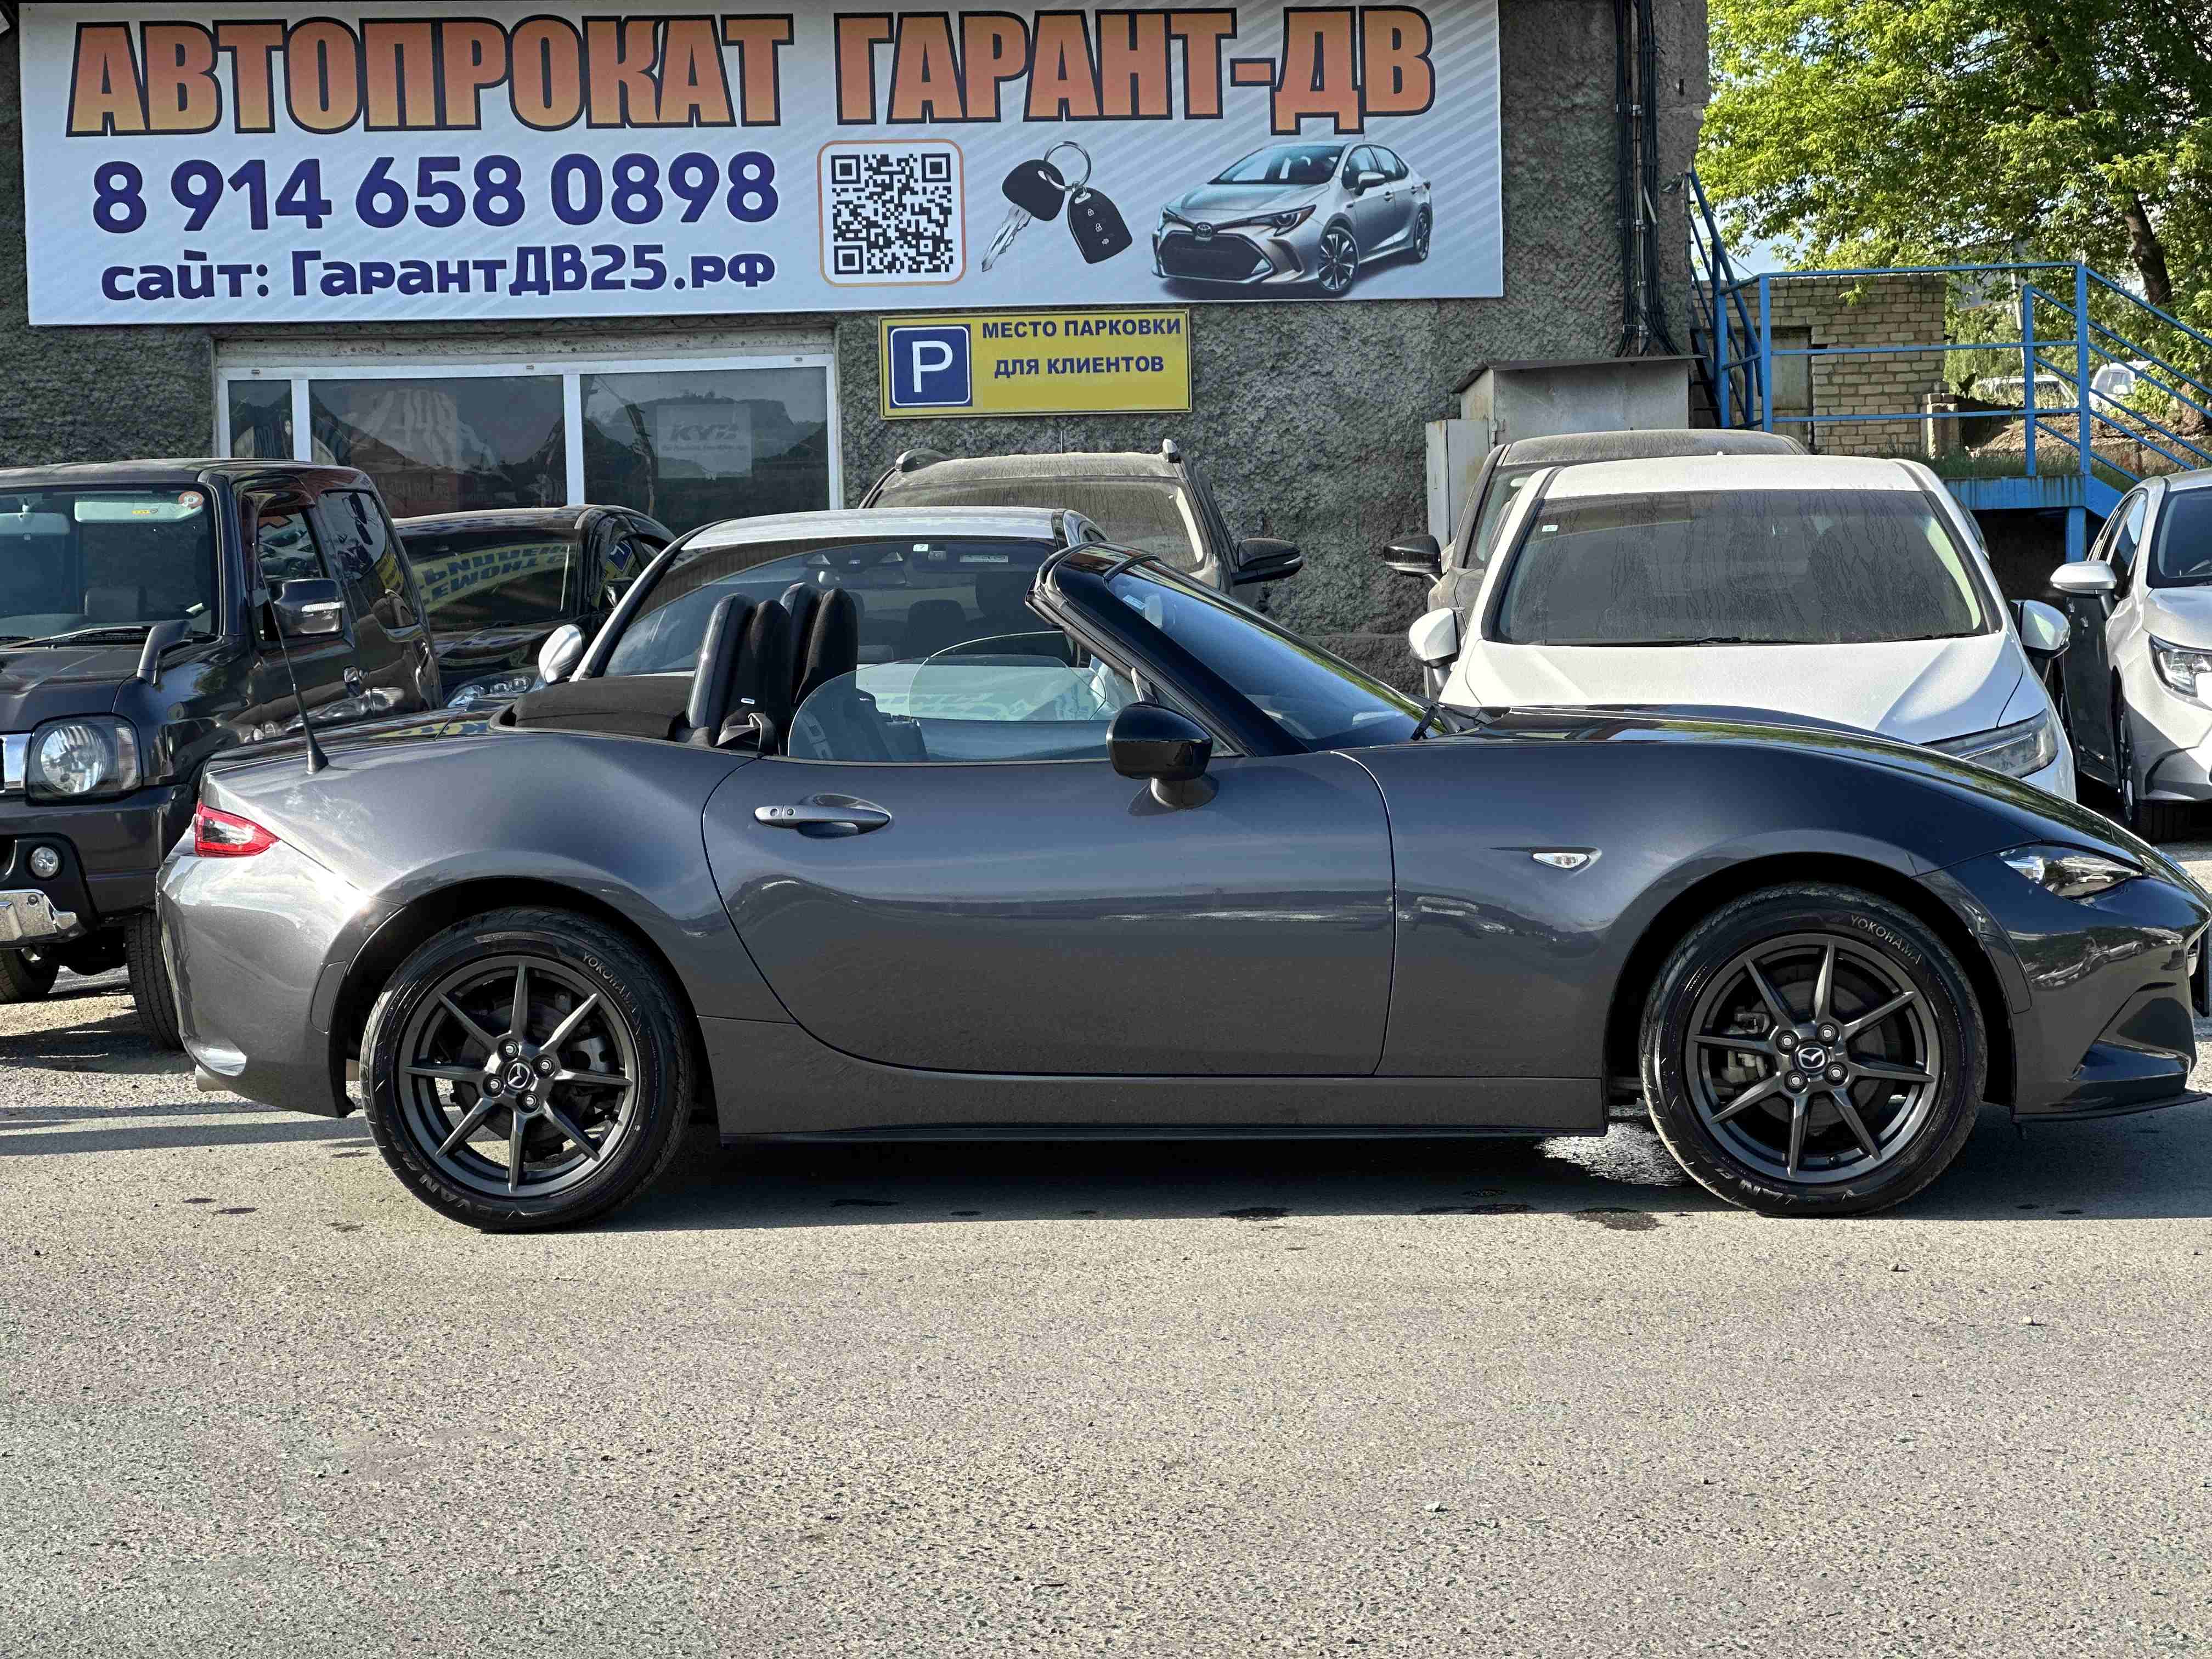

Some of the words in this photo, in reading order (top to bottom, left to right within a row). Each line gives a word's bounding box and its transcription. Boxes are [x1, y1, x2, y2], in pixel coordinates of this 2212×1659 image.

[66, 13, 794, 137] АВТОПРОКАТ
[832, 5, 1435, 136] ГАРАНТ-ДВ
[92, 160, 147, 233] 8
[170, 159, 332, 231] 914
[355, 155, 525, 228] 658
[550, 151, 779, 225] 0898
[101, 250, 269, 301] сайт:
[291, 244, 776, 297] ГарантДВ25.рф
[982, 321, 1057, 338] МЕСТО
[1064, 318, 1181, 336] ПАРКОВКИ
[912, 340, 953, 392] P
[994, 359, 1039, 379] ДЛЯ
[1047, 356, 1164, 374] КЛИЕНТОВ
